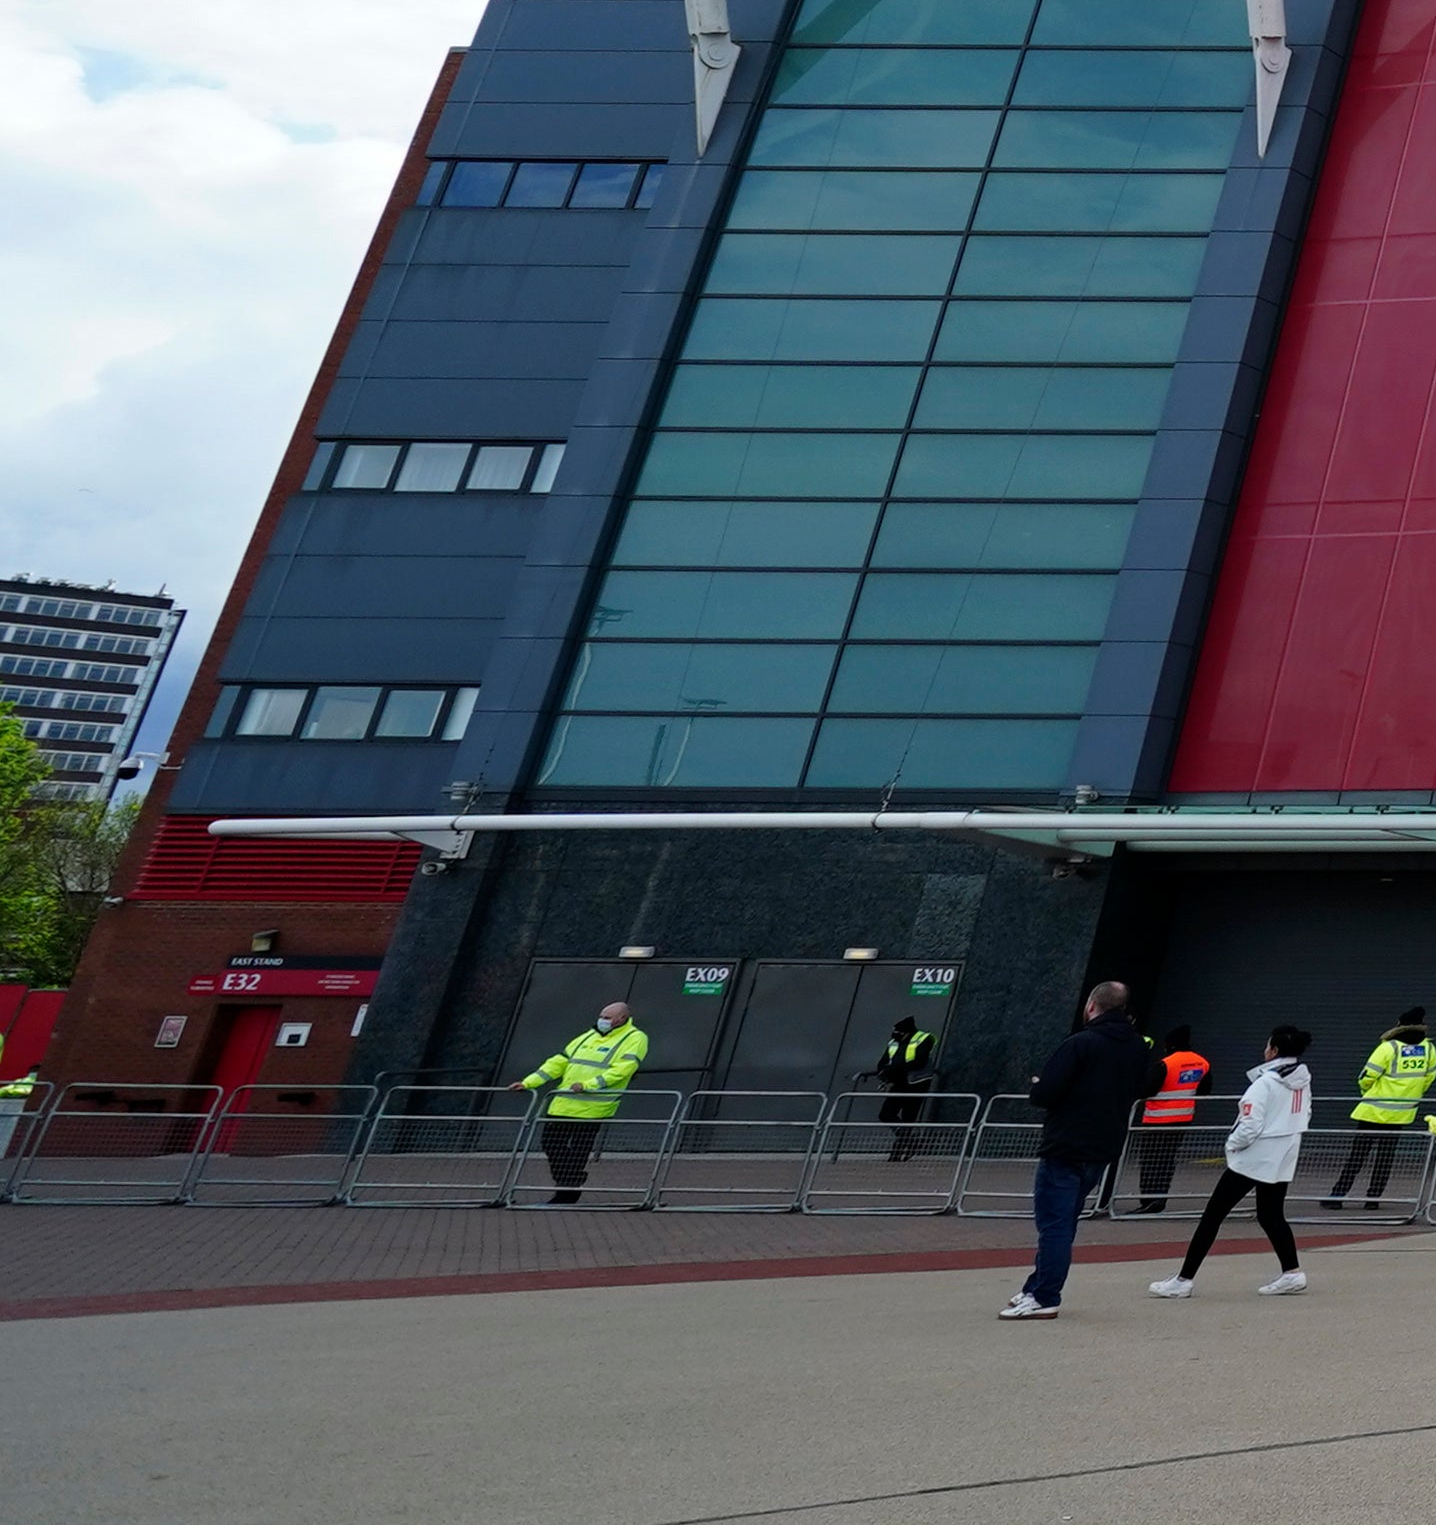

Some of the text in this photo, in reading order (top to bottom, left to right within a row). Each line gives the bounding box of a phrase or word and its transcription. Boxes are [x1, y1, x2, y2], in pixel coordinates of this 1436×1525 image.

[231, 957, 283, 966] EAST STAND
[685, 967, 729, 982] EX09
[912, 968, 955, 983] EX10
[222, 974, 262, 991] E32
[1402, 1059, 1425, 1069] 532
